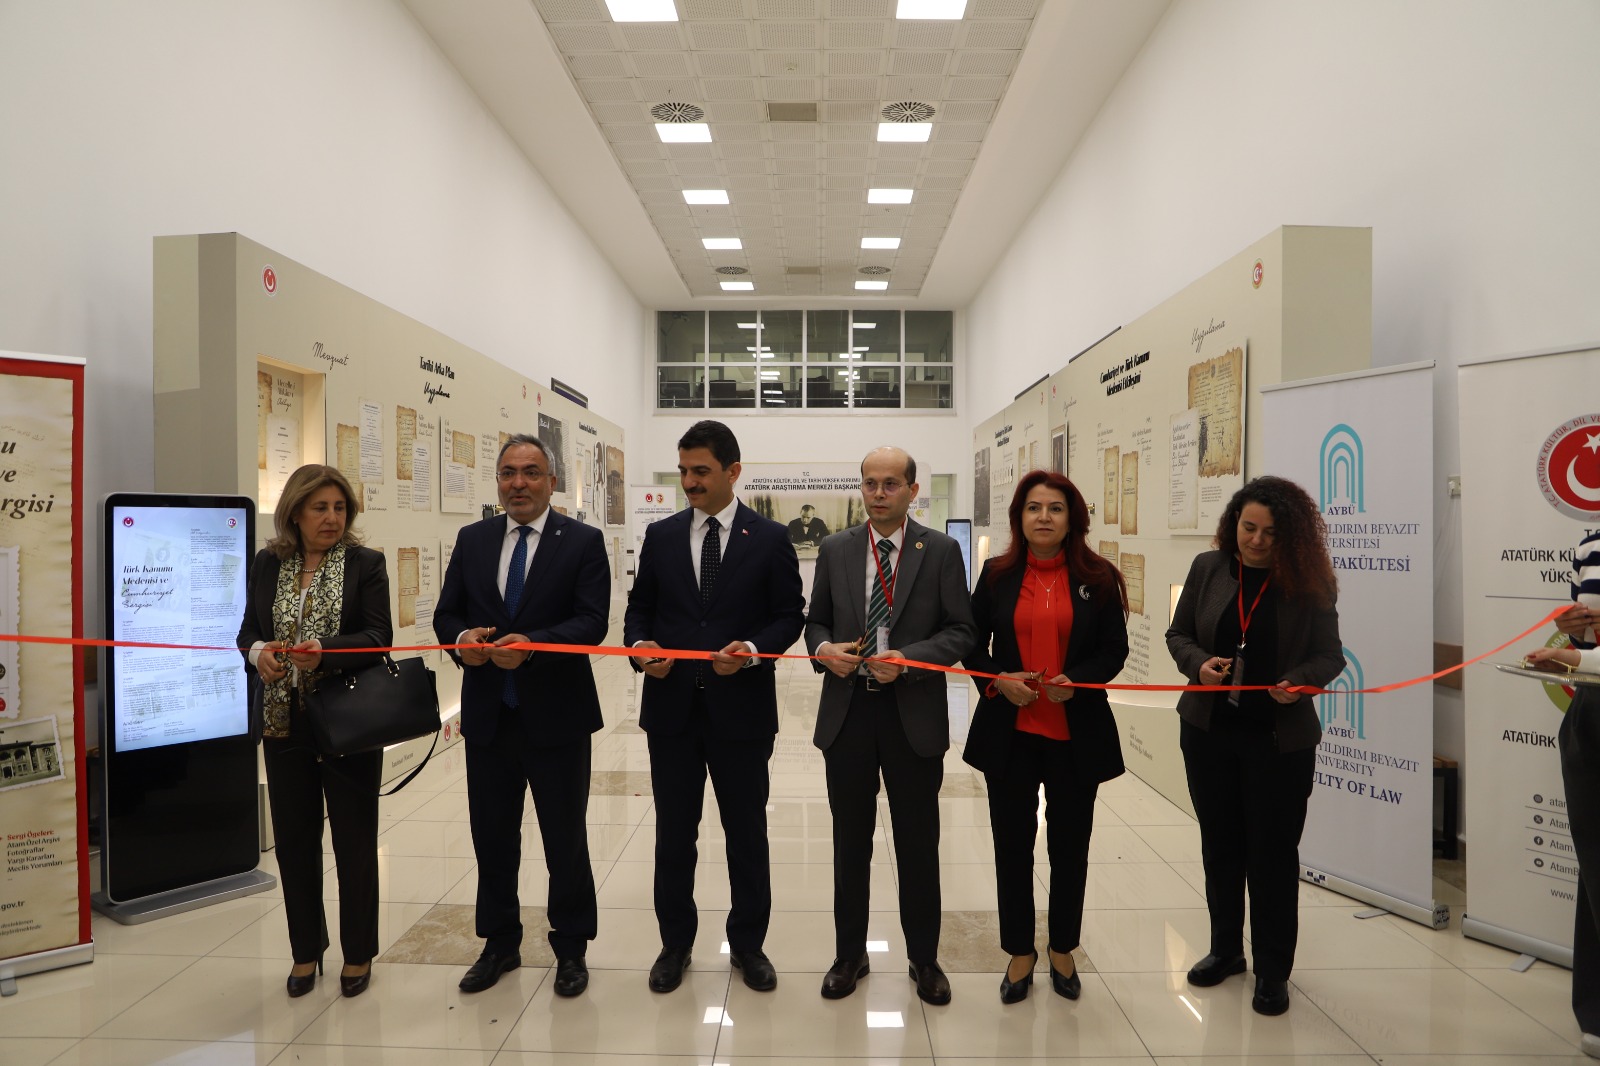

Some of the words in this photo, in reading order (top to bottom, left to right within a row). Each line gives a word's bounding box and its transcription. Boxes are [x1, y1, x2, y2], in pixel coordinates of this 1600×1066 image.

[0, 441, 16, 454] u
[1538, 456, 1550, 493] ATATÜRK
[1573, 417, 1586, 427] DİL
[0, 494, 54, 519] rgisi
[1327, 504, 1355, 515] AYBÜ
[1371, 524, 1420, 534] BEYAZIT
[1501, 547, 1555, 562] ATATÜRK
[1560, 547, 1575, 562] KÜ
[1332, 554, 1411, 572] FAKÜLTESİ
[1540, 568, 1572, 583] YÜKS
[1327, 726, 1355, 739] AYBÜ
[1503, 730, 1556, 748] ATATÜRK
[1315, 754, 1375, 776] NIVERSITY
[1370, 752, 1420, 772] BEYAZIT
[1347, 780, 1367, 795] OF
[1370, 785, 1402, 805] LAW
[1550, 839, 1574, 852] Atam
[1550, 862, 1579, 876] AtamB
[1550, 889, 1576, 901] www.
[0, 900, 25, 911] gov.tr
